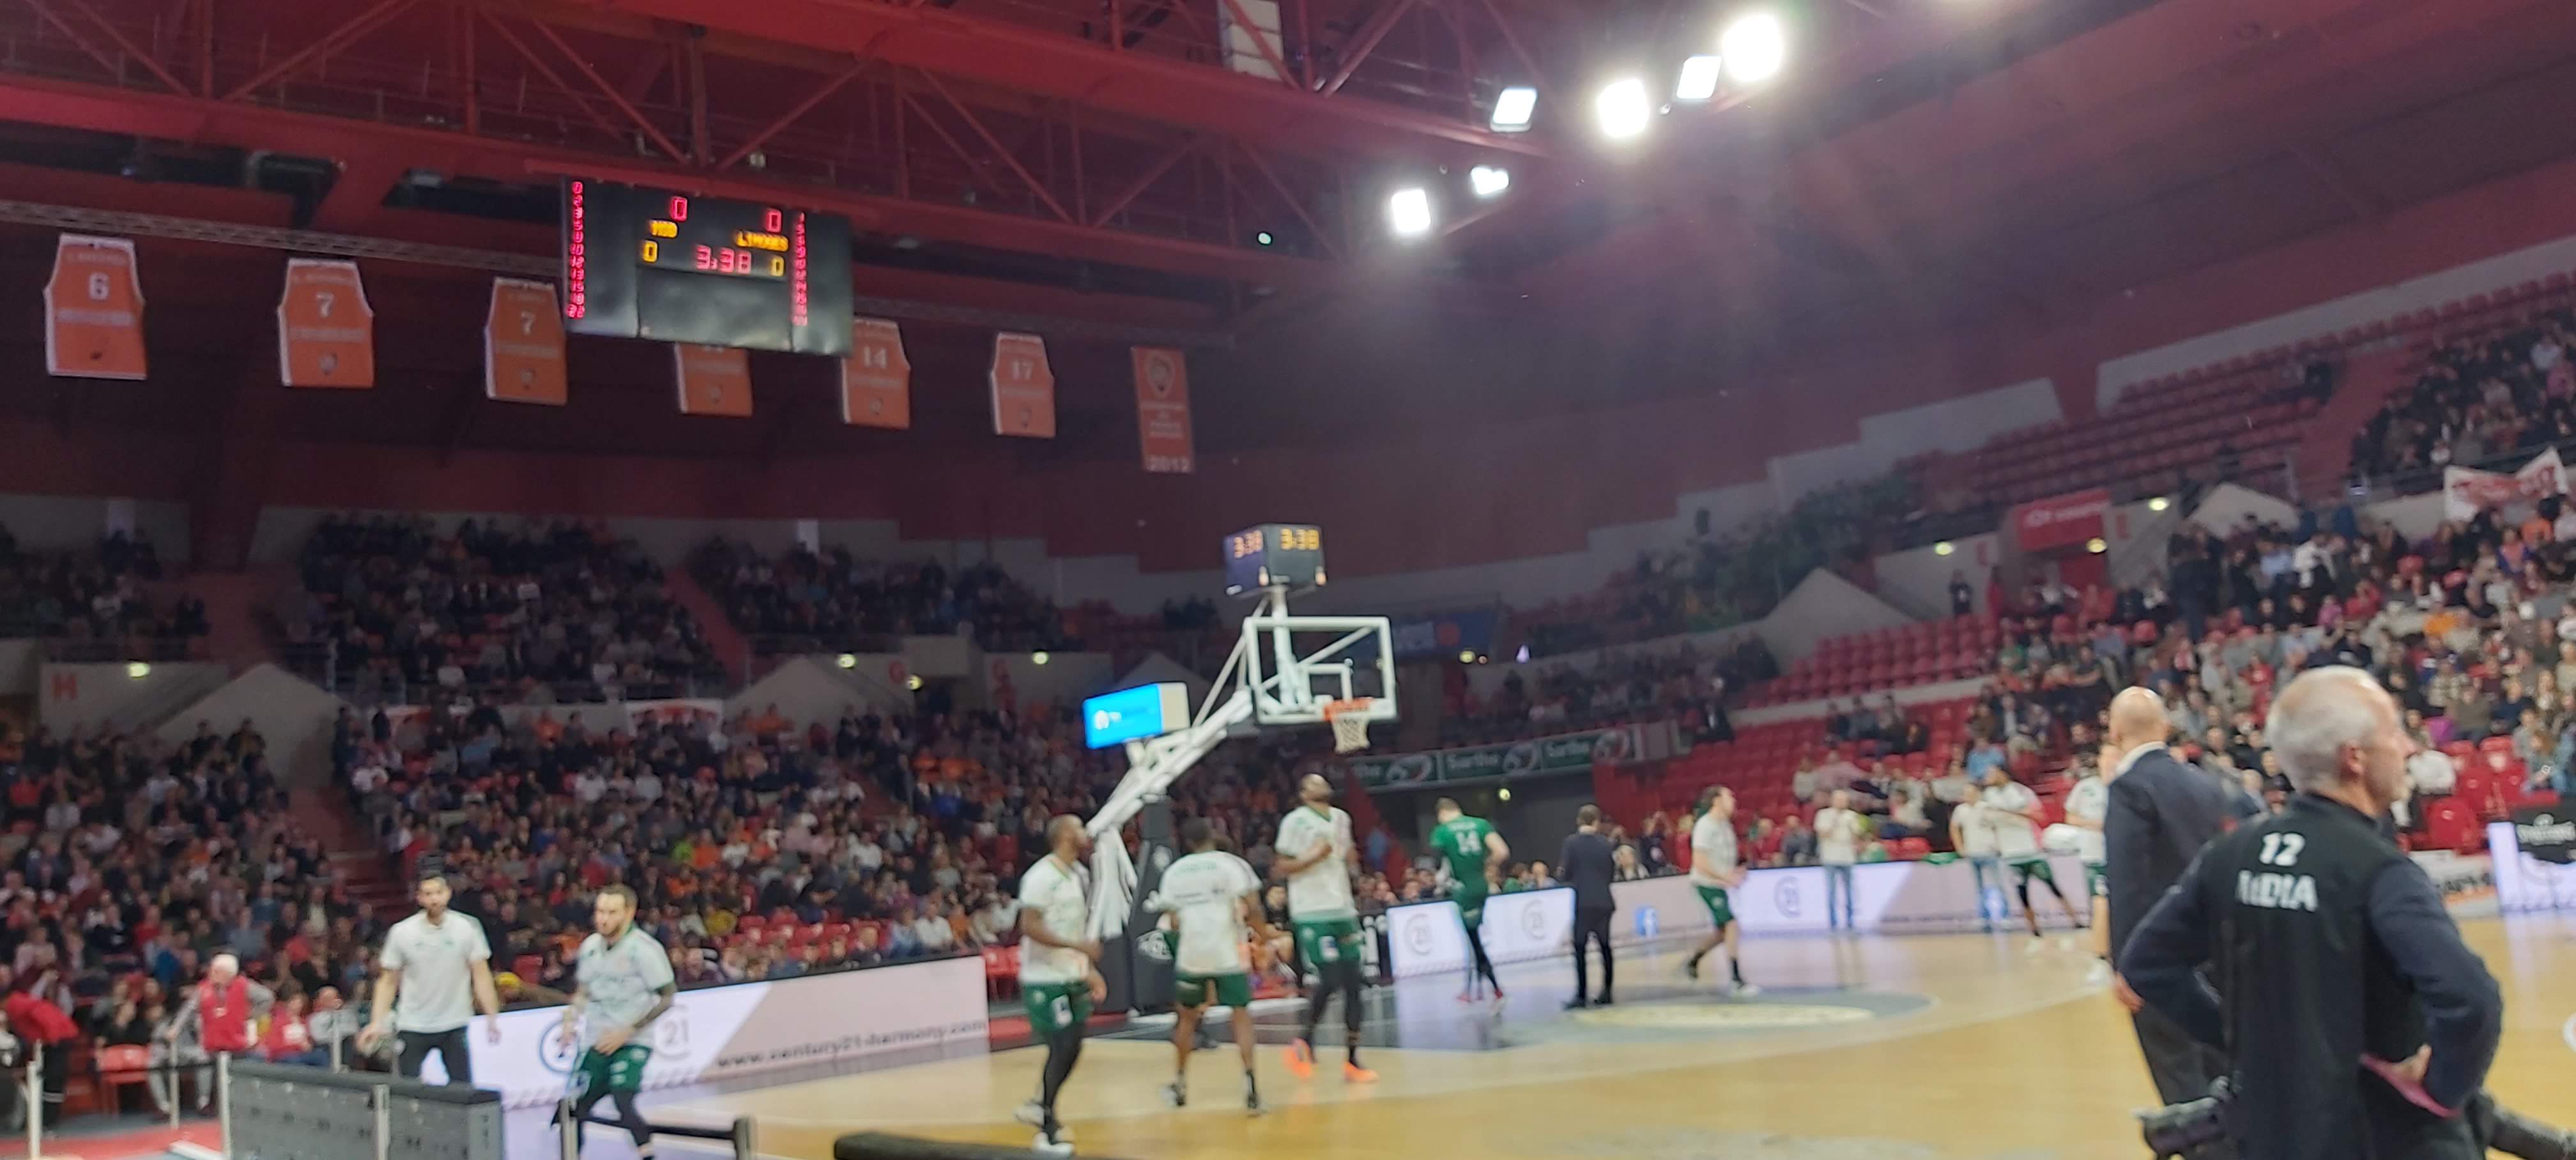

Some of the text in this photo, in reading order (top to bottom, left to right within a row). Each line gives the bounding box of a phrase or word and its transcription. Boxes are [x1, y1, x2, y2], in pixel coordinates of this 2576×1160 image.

[671, 197, 687, 221] 0
[767, 209, 781, 233] 0
[642, 240, 657, 262] 0
[770, 256, 785, 277] 0
[88, 272, 109, 300] 6
[316, 292, 335, 317] 7
[521, 311, 535, 335] 7
[863, 346, 887, 369] 14
[1456, 830, 1482, 855] 14
[2259, 832, 2305, 866] 12
